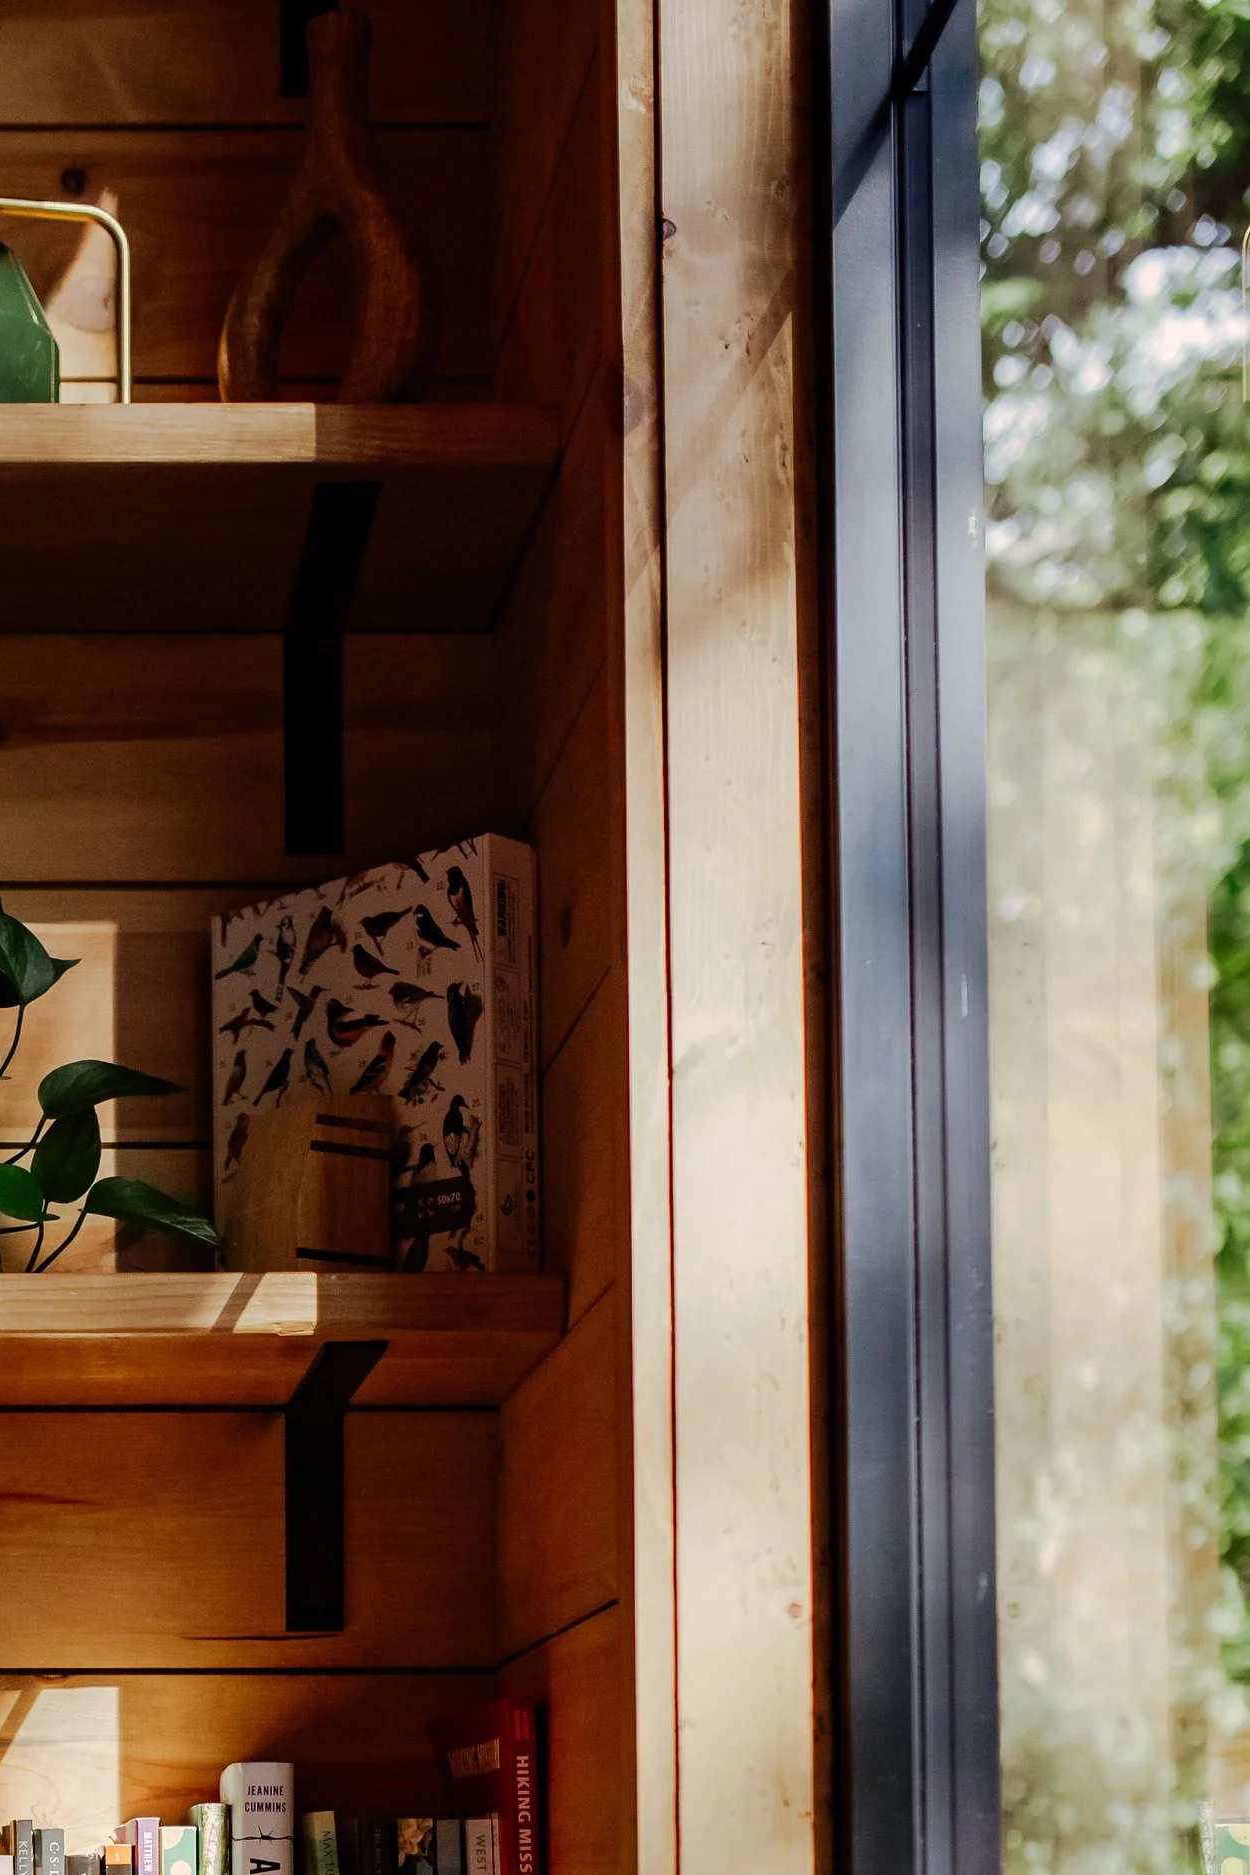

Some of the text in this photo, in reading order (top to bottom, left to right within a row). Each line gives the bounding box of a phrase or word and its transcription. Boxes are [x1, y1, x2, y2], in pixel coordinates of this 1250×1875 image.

[497, 880, 507, 937] WARNING
[526, 1150, 535, 1185] CPC
[245, 1802, 286, 1812] CUMMINS
[247, 1785, 284, 1796] JEANINE
[516, 1755, 532, 1823] HIKING
[143, 1832, 152, 1872] MATTHEW
[322, 1830, 334, 1858] MAX
[476, 1834, 488, 1872] WEST
